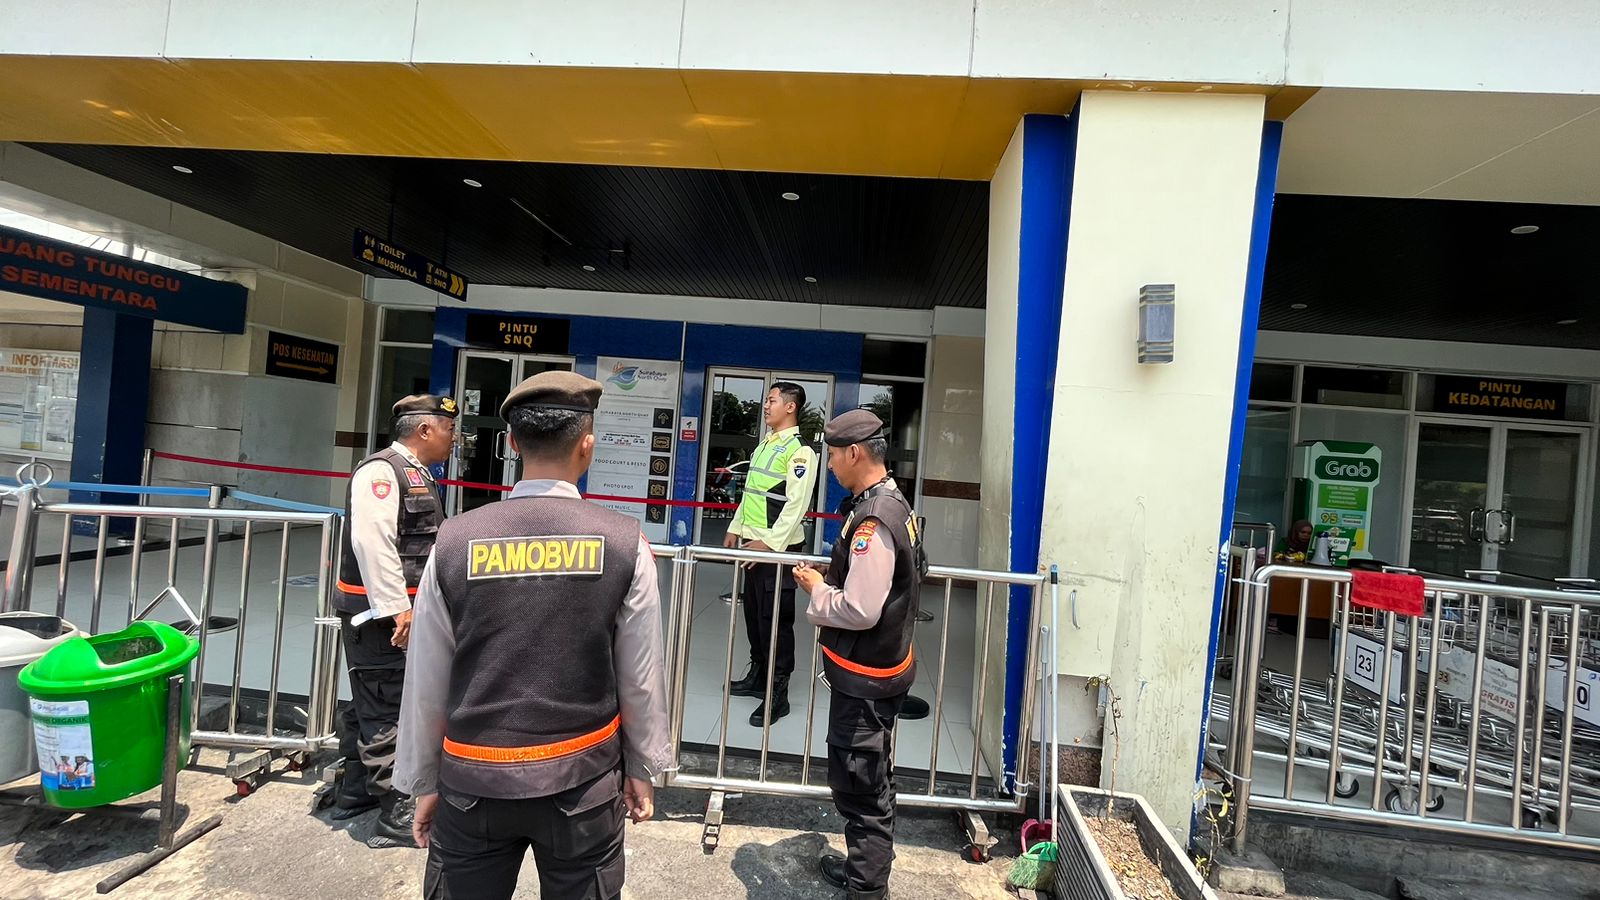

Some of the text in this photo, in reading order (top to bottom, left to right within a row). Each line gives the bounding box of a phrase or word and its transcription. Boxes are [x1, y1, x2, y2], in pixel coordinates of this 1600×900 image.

[378, 242, 407, 260] TOILET
[0, 237, 182, 292] UANG TUNGGU
[376, 256, 418, 279] MUSHOLLA
[434, 267, 448, 279] ATM
[1, 265, 158, 311] SEMENTARA
[499, 322, 538, 334] PINTU
[272, 342, 290, 358] POS
[503, 334, 533, 349] SNQ
[291, 345, 335, 366] KESEHATAN
[1479, 381, 1522, 395] PINTU
[1448, 391, 1556, 411] KEDATANGAN
[1325, 460, 1372, 478] Grab
[471, 540, 602, 574] PAMOBVIT
[1358, 654, 1373, 673] 23
[1481, 689, 1516, 709] GRATIS
